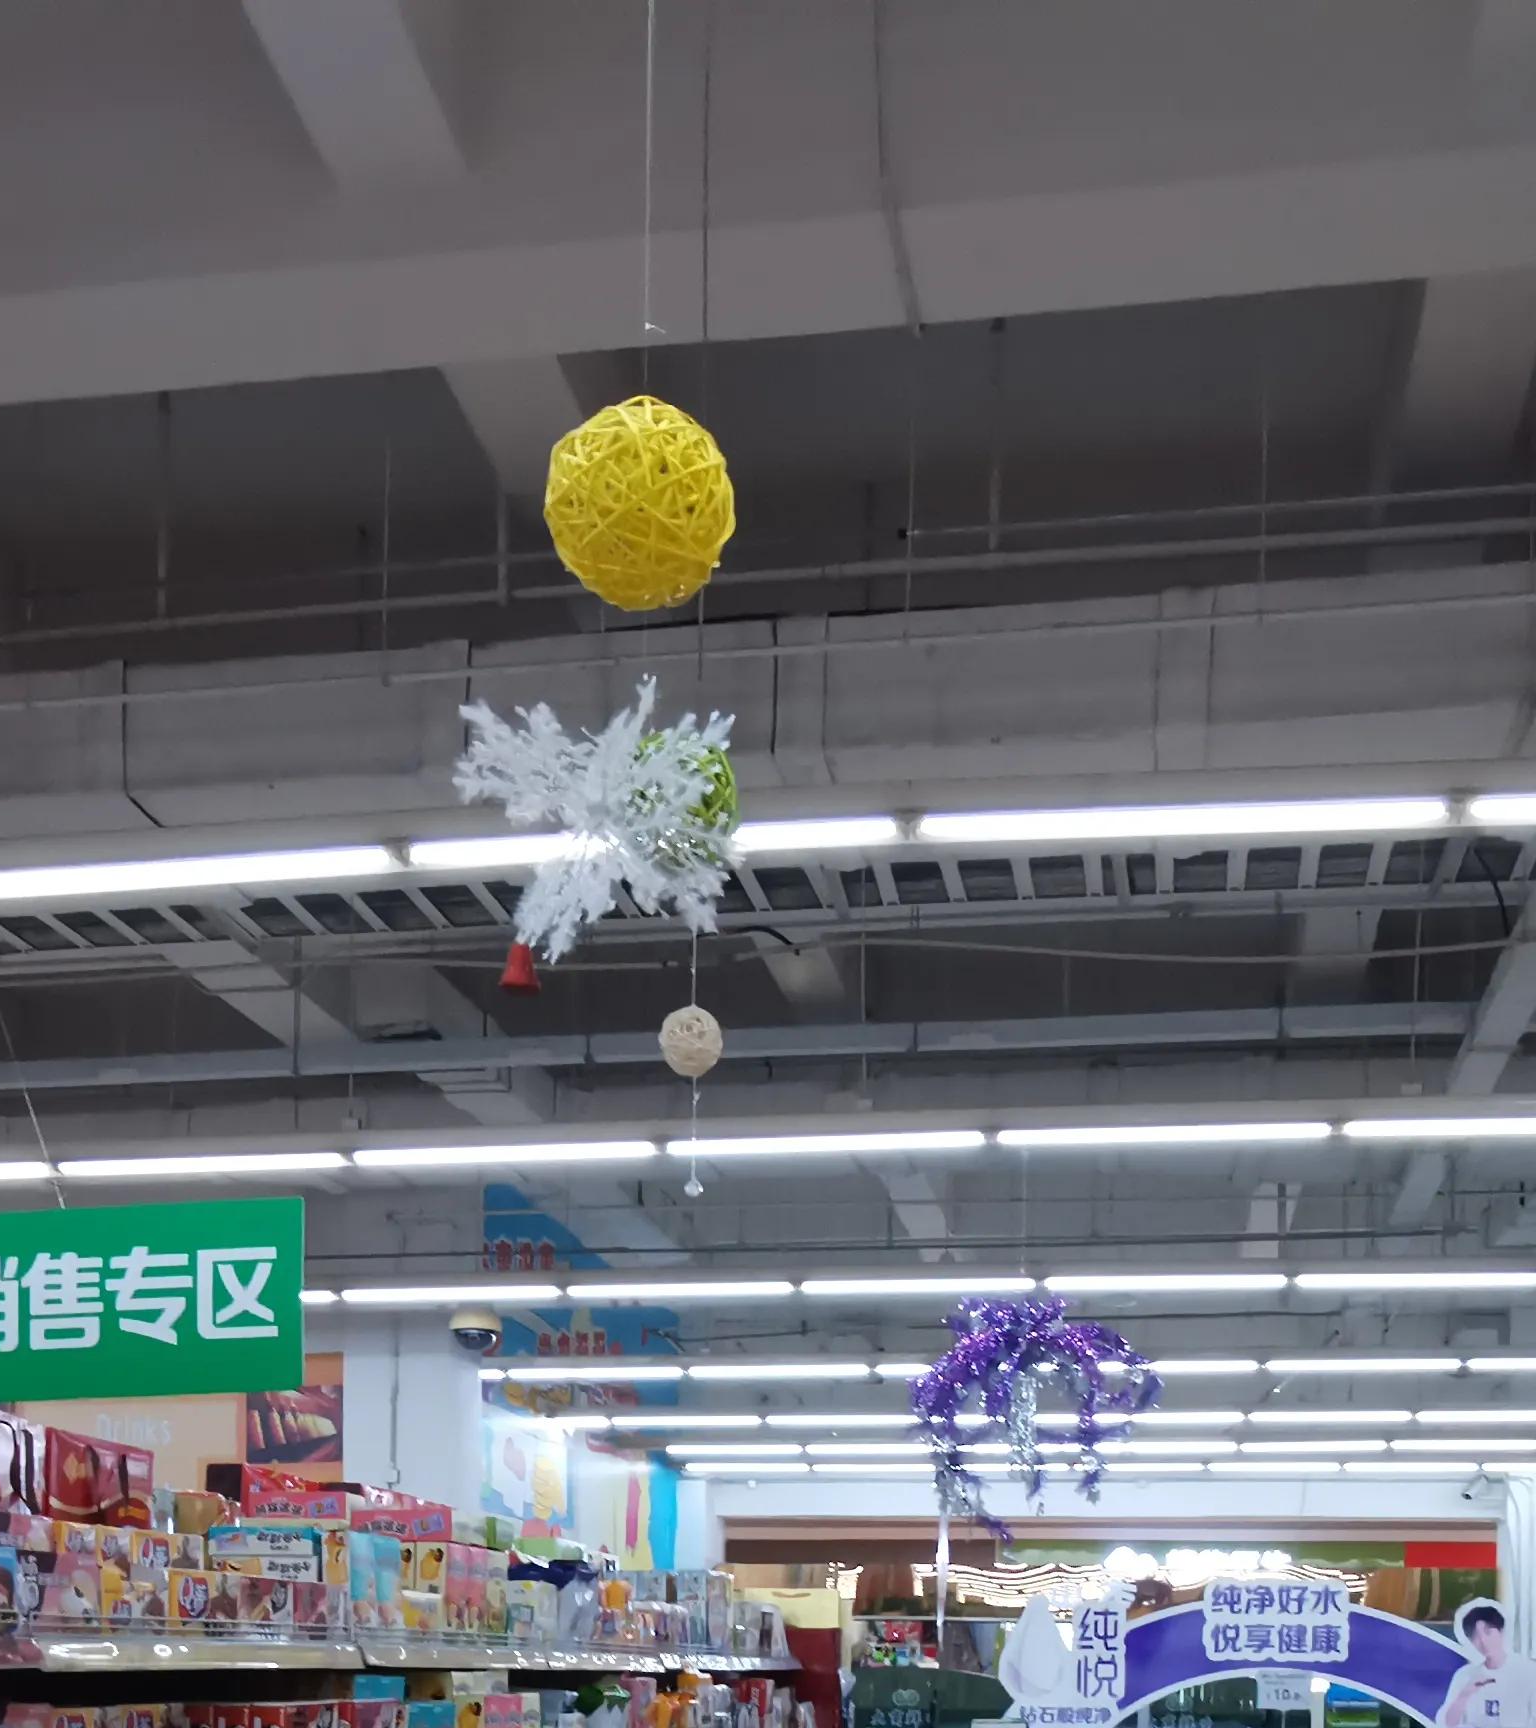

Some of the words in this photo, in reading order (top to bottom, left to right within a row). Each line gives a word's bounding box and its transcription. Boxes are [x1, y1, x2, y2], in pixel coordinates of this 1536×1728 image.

[1211, 1584, 1342, 1616] 纯净好水
[1076, 1607, 1119, 1699] 纯悦
[1211, 1623, 1343, 1654] 悦享健康
